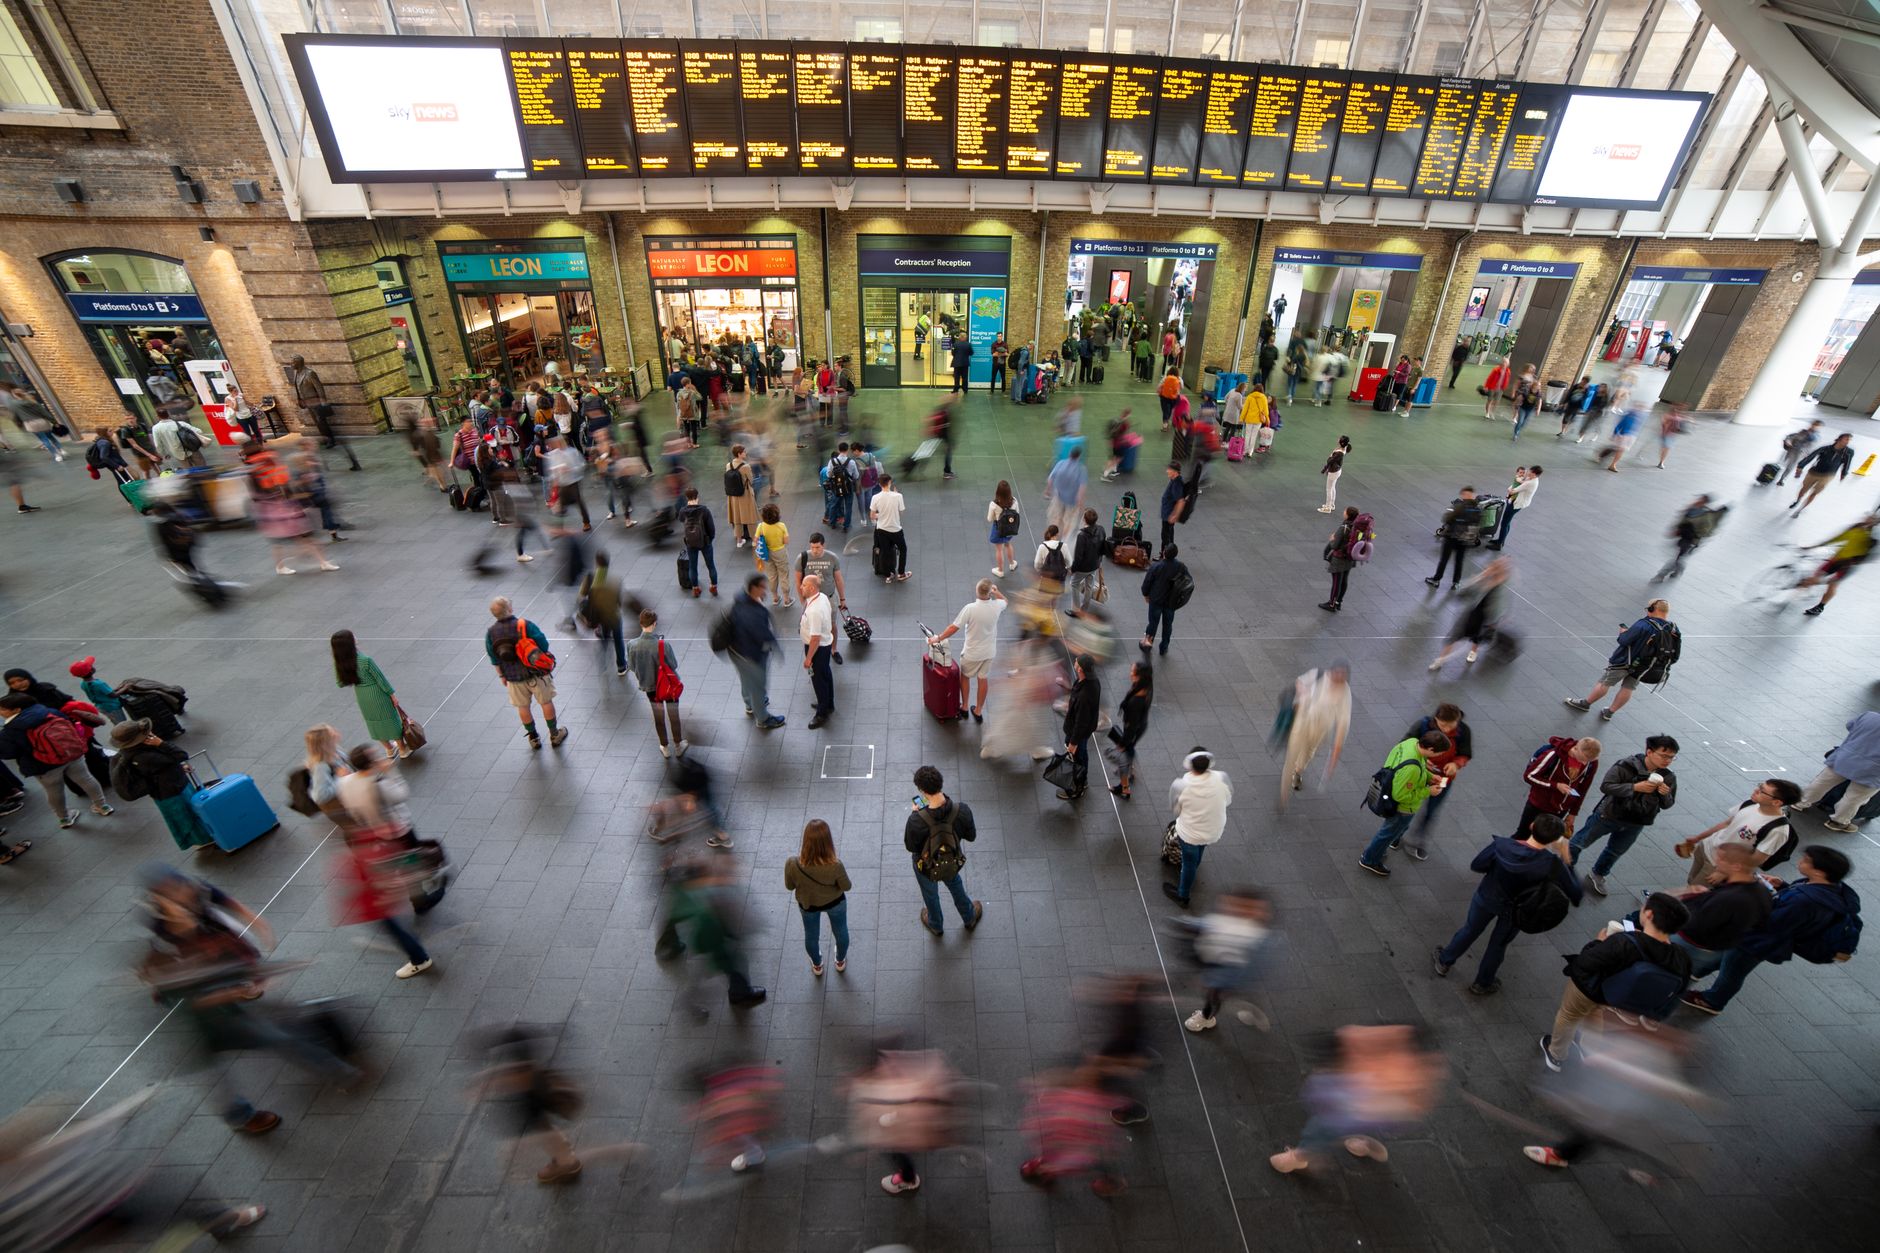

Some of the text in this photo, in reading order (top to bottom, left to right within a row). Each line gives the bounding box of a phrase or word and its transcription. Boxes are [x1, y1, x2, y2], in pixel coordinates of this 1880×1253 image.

[416, 106, 456, 118] news
[490, 258, 542, 276] LEON
[696, 254, 748, 272] LEON
[937, 259, 971, 267] Reception
[92, 302, 130, 311] Platforms
[138, 303, 147, 311] to
[148, 303, 154, 311] 8
